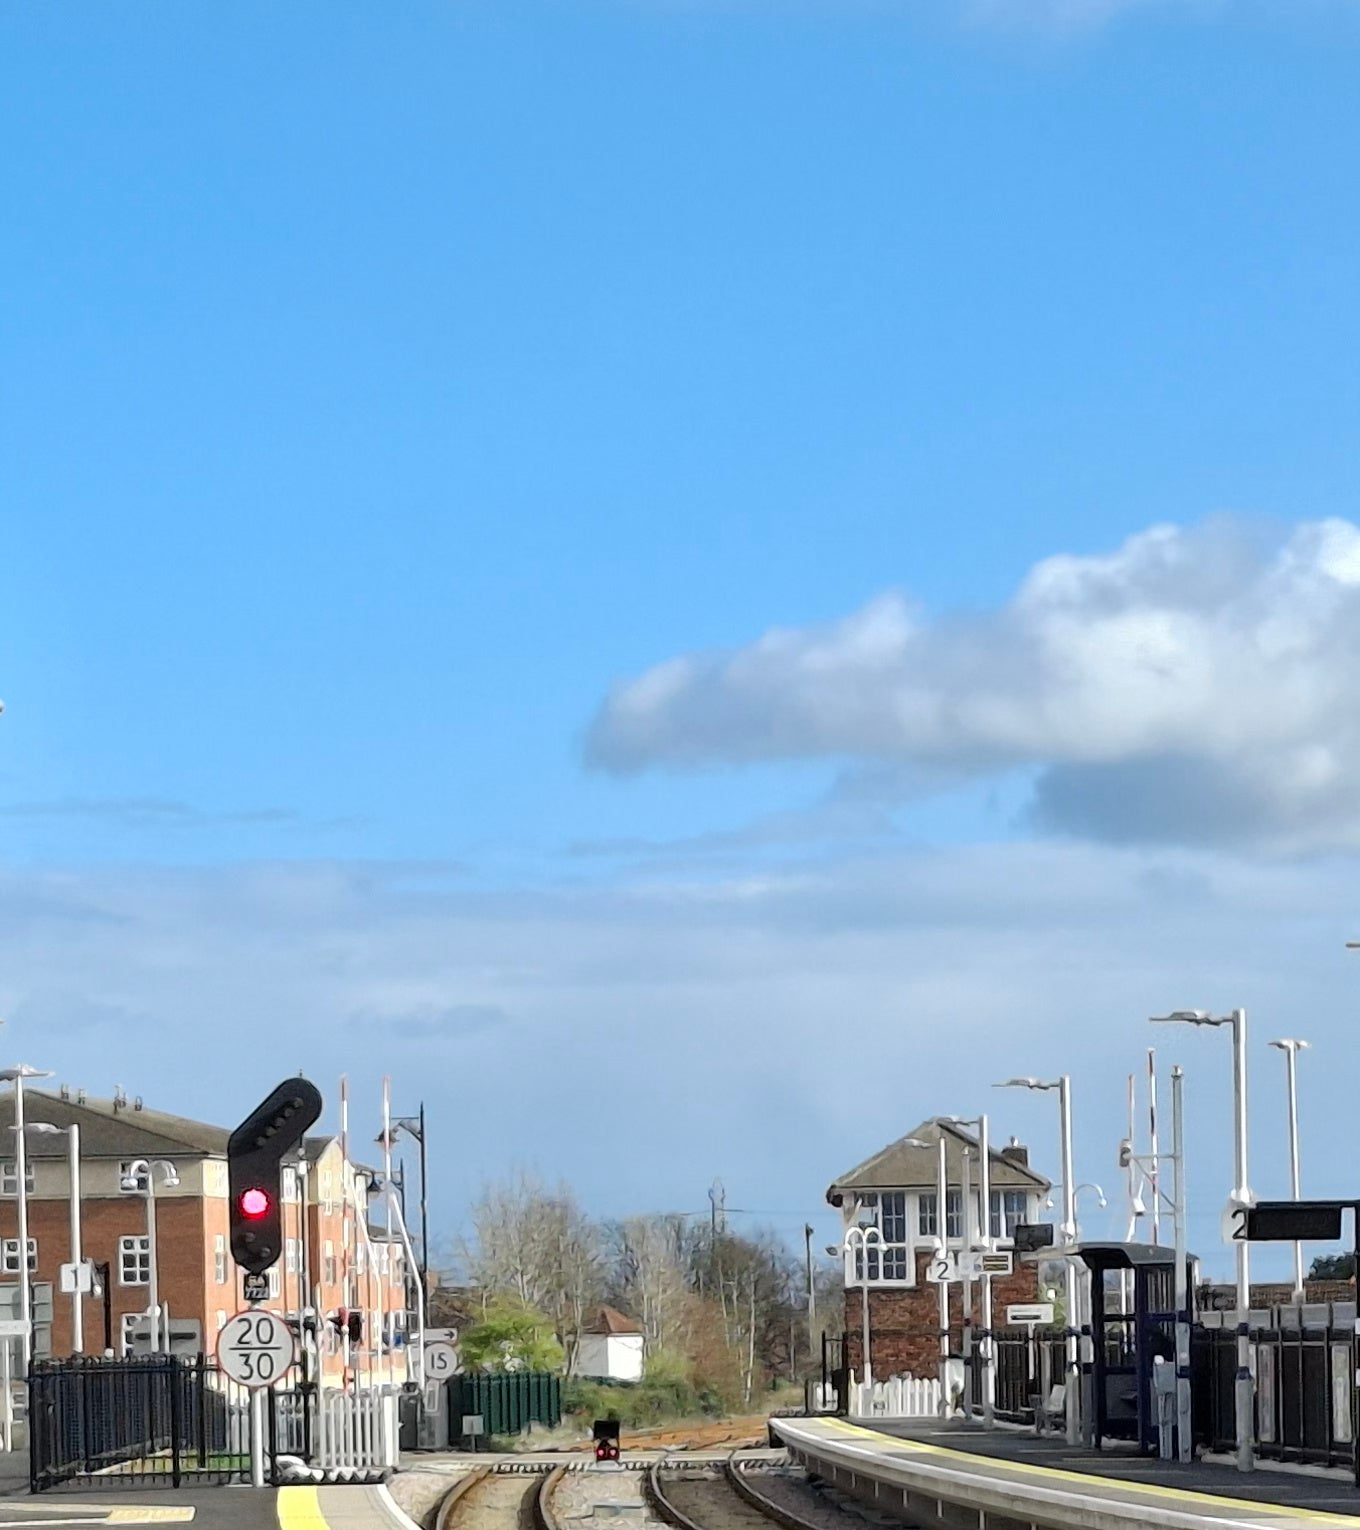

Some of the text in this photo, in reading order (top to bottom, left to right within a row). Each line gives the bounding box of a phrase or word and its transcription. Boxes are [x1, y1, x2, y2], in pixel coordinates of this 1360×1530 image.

[1231, 1208, 1248, 1240] 2
[936, 1261, 950, 1280] 2
[237, 1317, 275, 1345] 20
[238, 1352, 274, 1380] 30
[431, 1352, 447, 1370] 15
